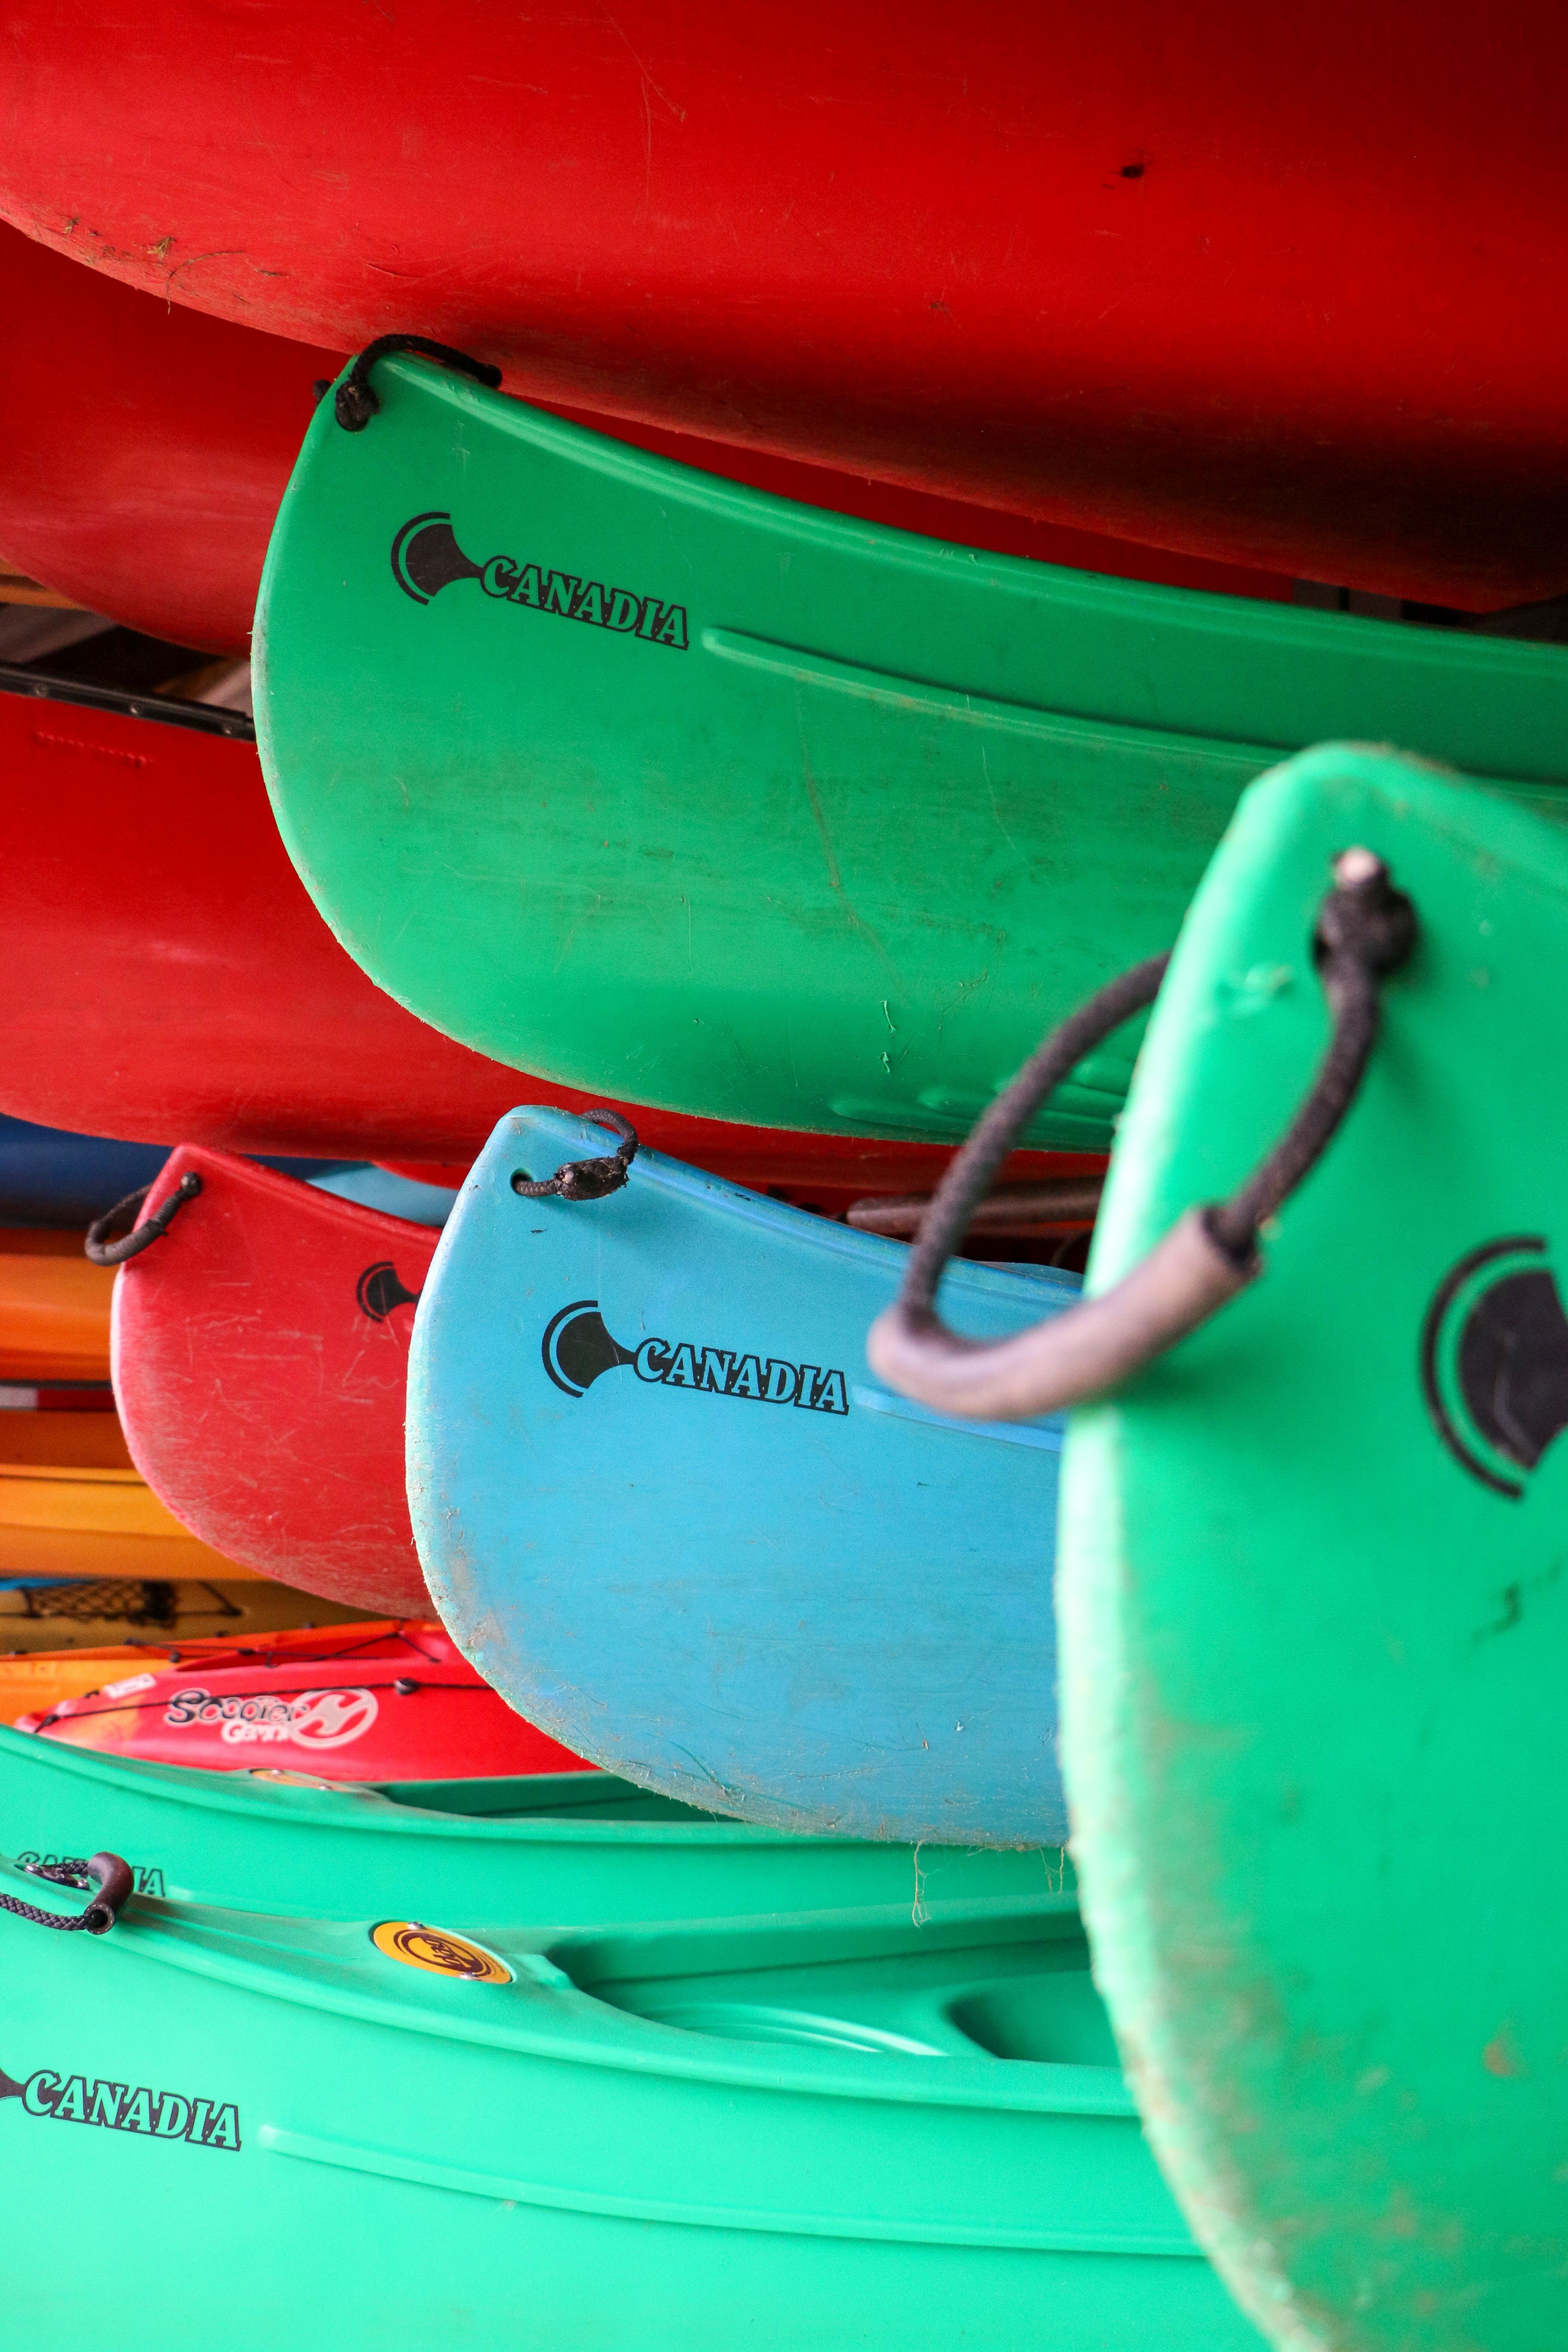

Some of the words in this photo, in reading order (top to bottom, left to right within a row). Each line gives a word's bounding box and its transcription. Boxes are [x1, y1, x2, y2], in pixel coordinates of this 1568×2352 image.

[480, 555, 689, 651] CANADIA
[633, 1337, 849, 1415] CANADIA
[21, 2069, 242, 2152] CANADIA
